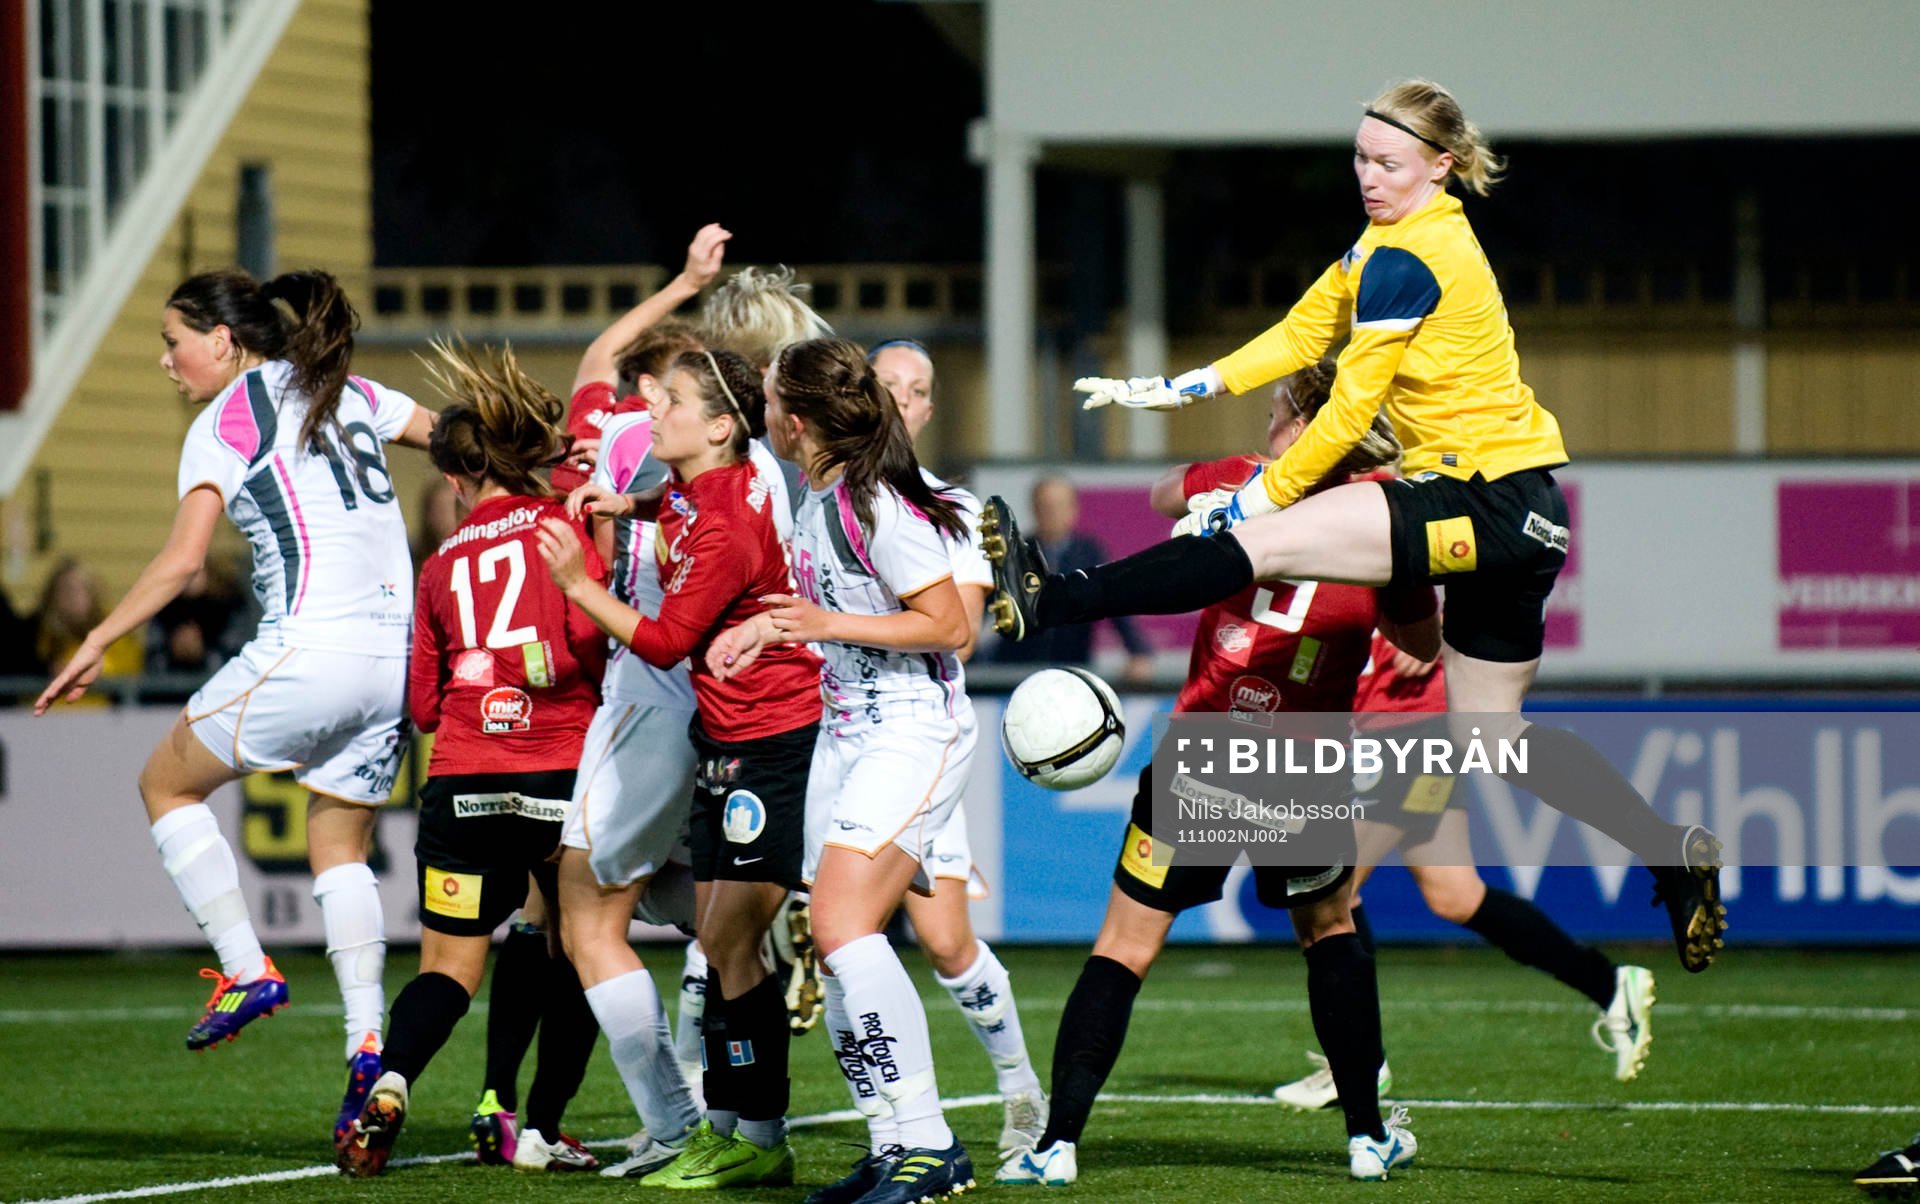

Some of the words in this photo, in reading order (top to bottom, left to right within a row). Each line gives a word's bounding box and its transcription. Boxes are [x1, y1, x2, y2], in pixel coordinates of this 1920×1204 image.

[307, 421, 396, 512] 18
[450, 539, 539, 649] 12
[489, 698, 524, 714] mix
[457, 799, 510, 815] Norra
[511, 796, 565, 818] Skåne
